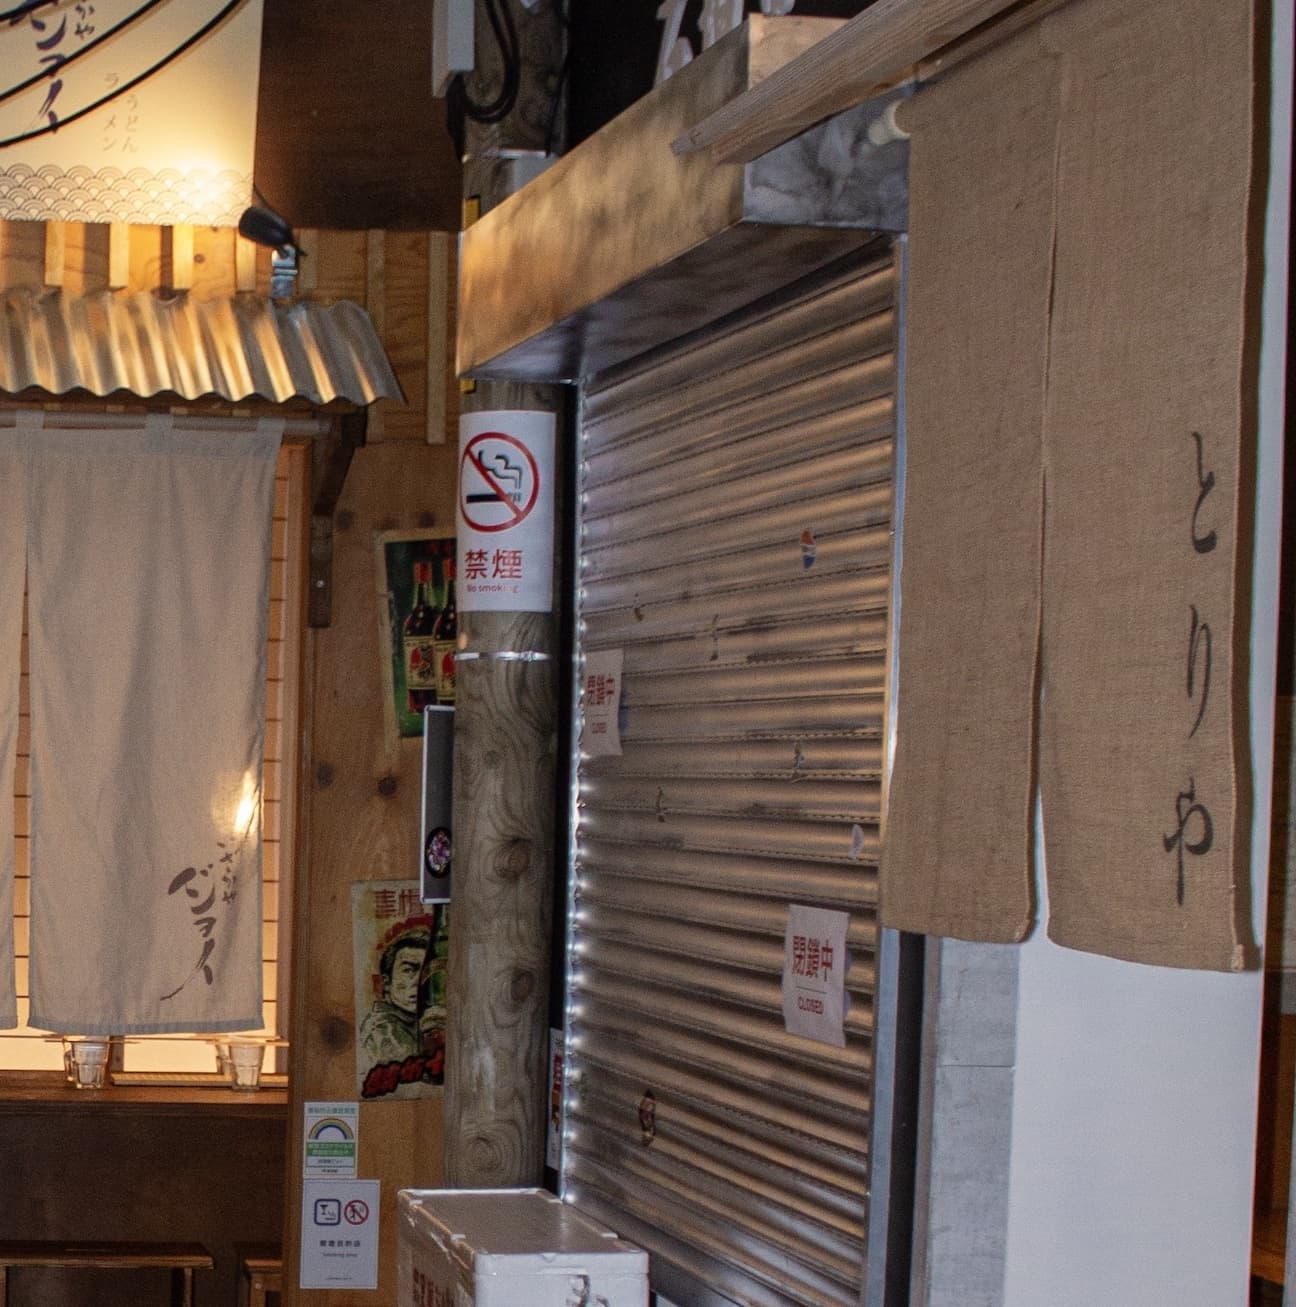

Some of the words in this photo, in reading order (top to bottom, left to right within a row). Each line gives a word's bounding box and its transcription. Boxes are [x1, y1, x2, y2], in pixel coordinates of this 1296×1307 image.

[464, 549, 523, 580] 禁煙
[1163, 431, 1218, 907] とりや
[792, 936, 834, 982] 閉鎖中
[797, 996, 825, 1015] CLOSED
